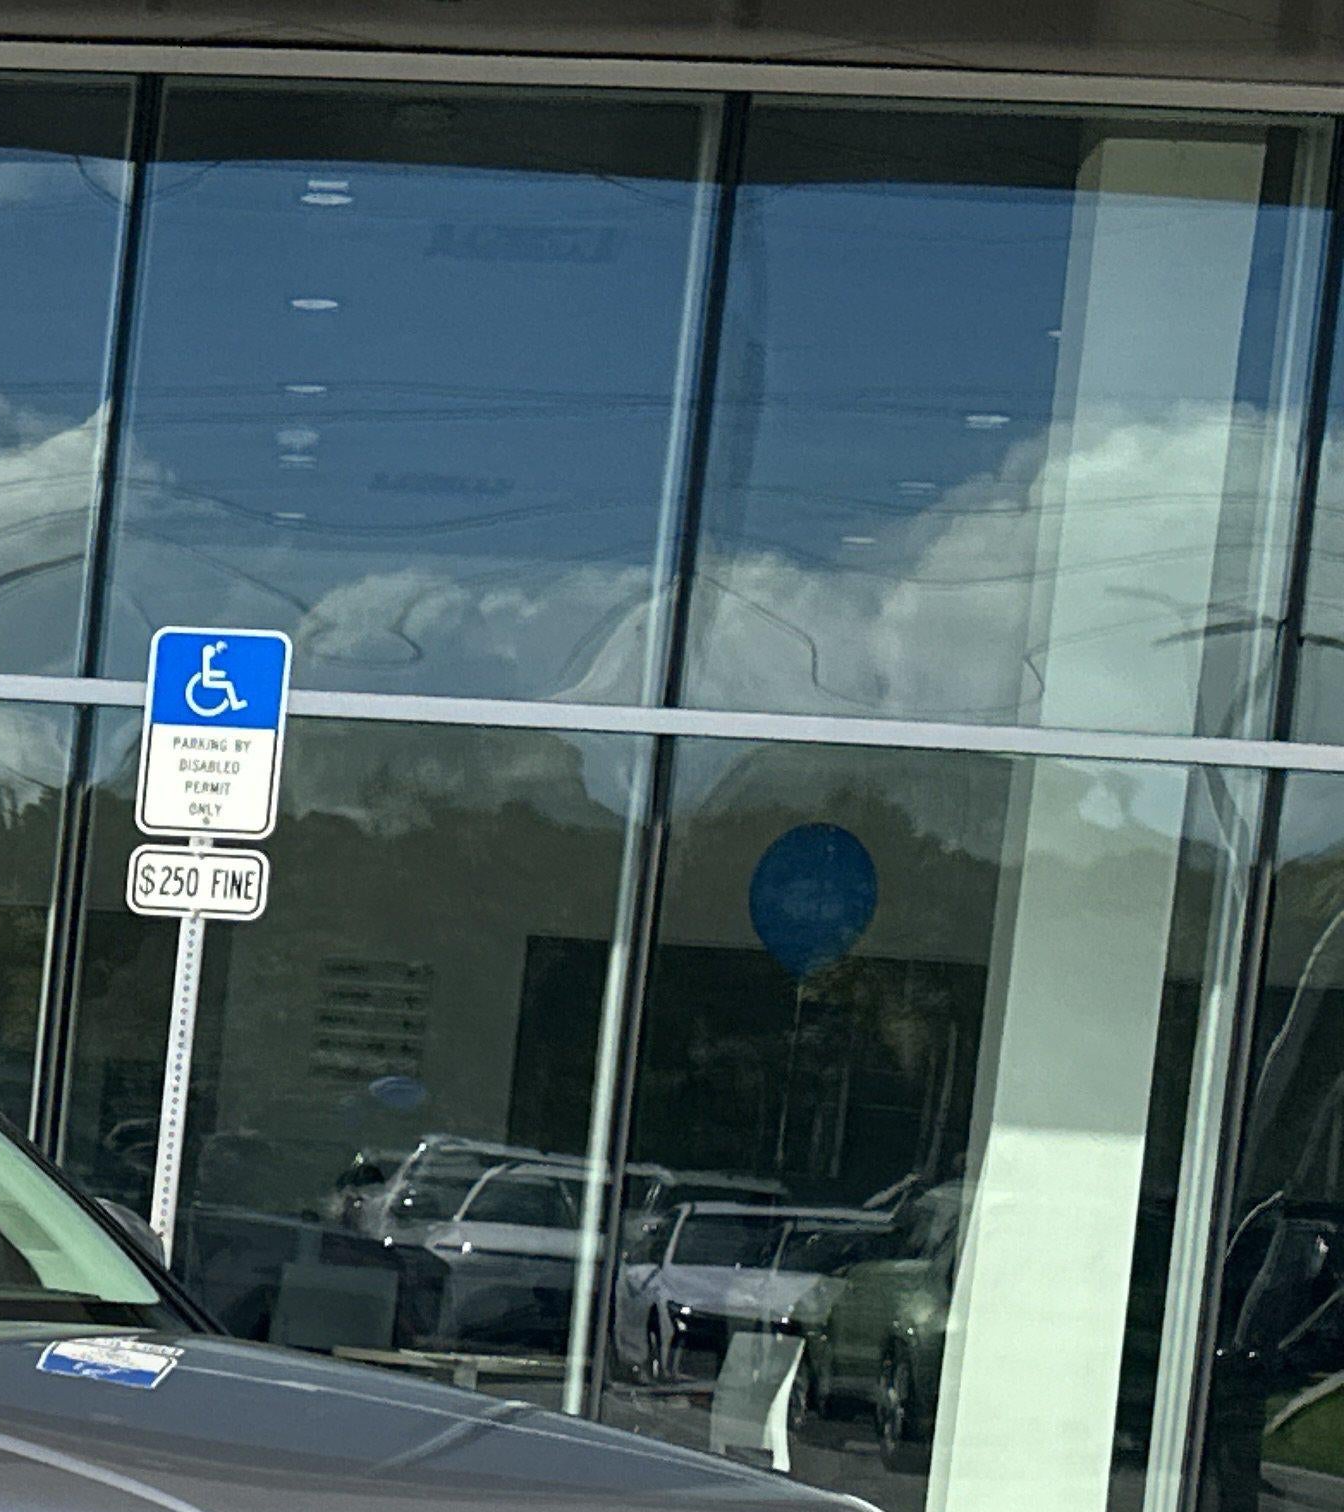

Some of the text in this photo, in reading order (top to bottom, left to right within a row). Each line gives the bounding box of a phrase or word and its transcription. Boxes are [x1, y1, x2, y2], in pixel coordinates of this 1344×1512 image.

[173, 736, 252, 753] PARKING BY
[179, 758, 240, 775] DISABLED
[185, 780, 231, 796] PERMIT
[189, 801, 222, 817] ONLY
[139, 864, 256, 900] $250 FINE
